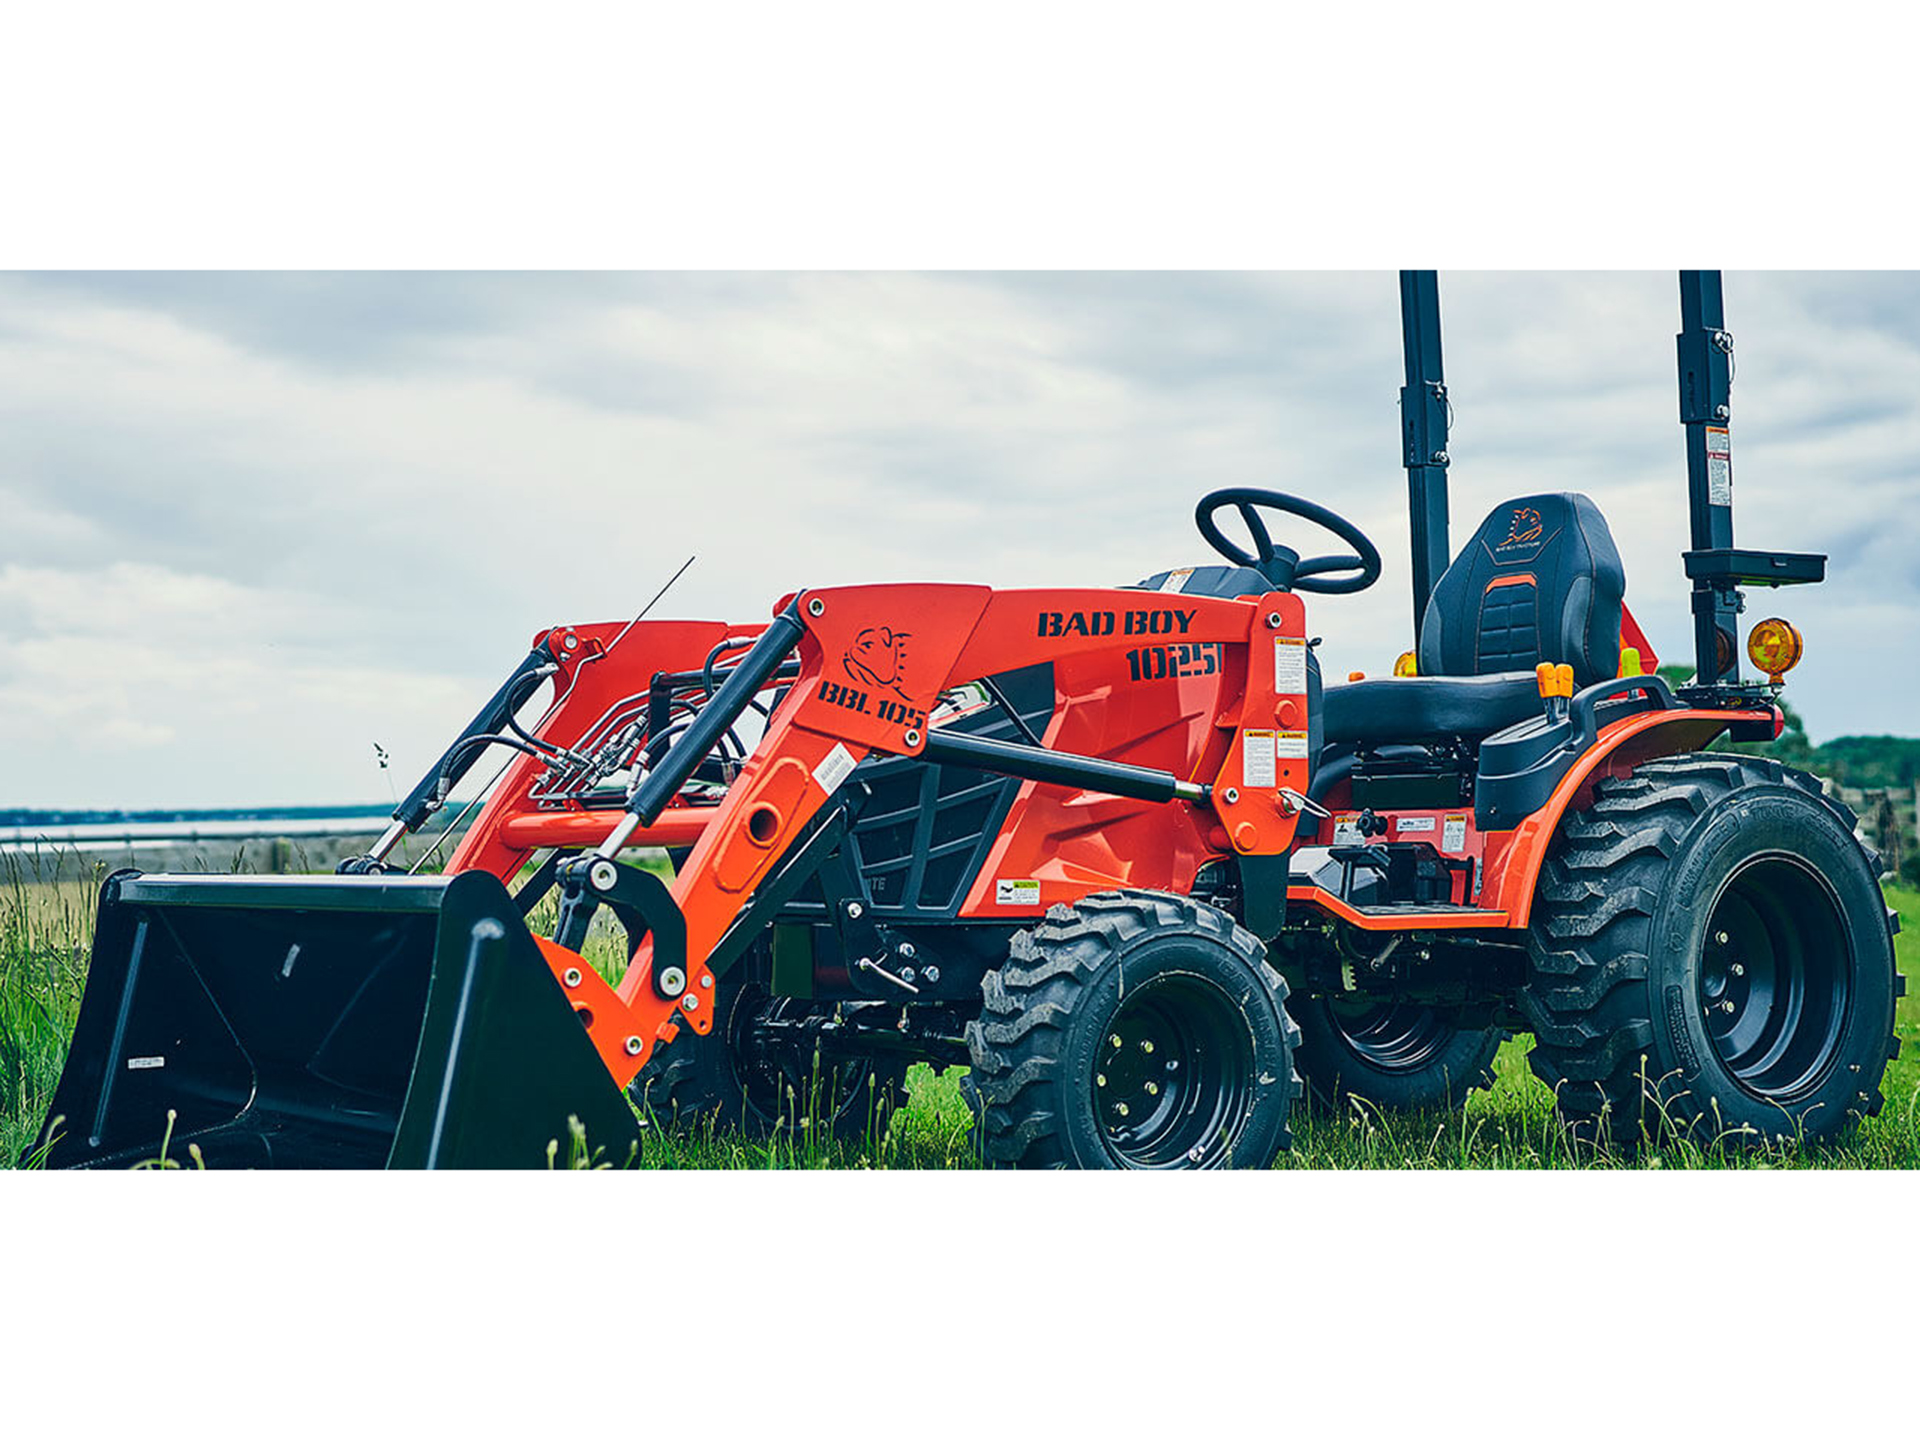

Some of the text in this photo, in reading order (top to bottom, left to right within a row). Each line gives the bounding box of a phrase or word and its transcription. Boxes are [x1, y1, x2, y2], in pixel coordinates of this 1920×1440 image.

[1037, 609, 1198, 637] BAD BOY
[1126, 643, 1222, 682] 1025
[818, 681, 926, 730] BBL 105
